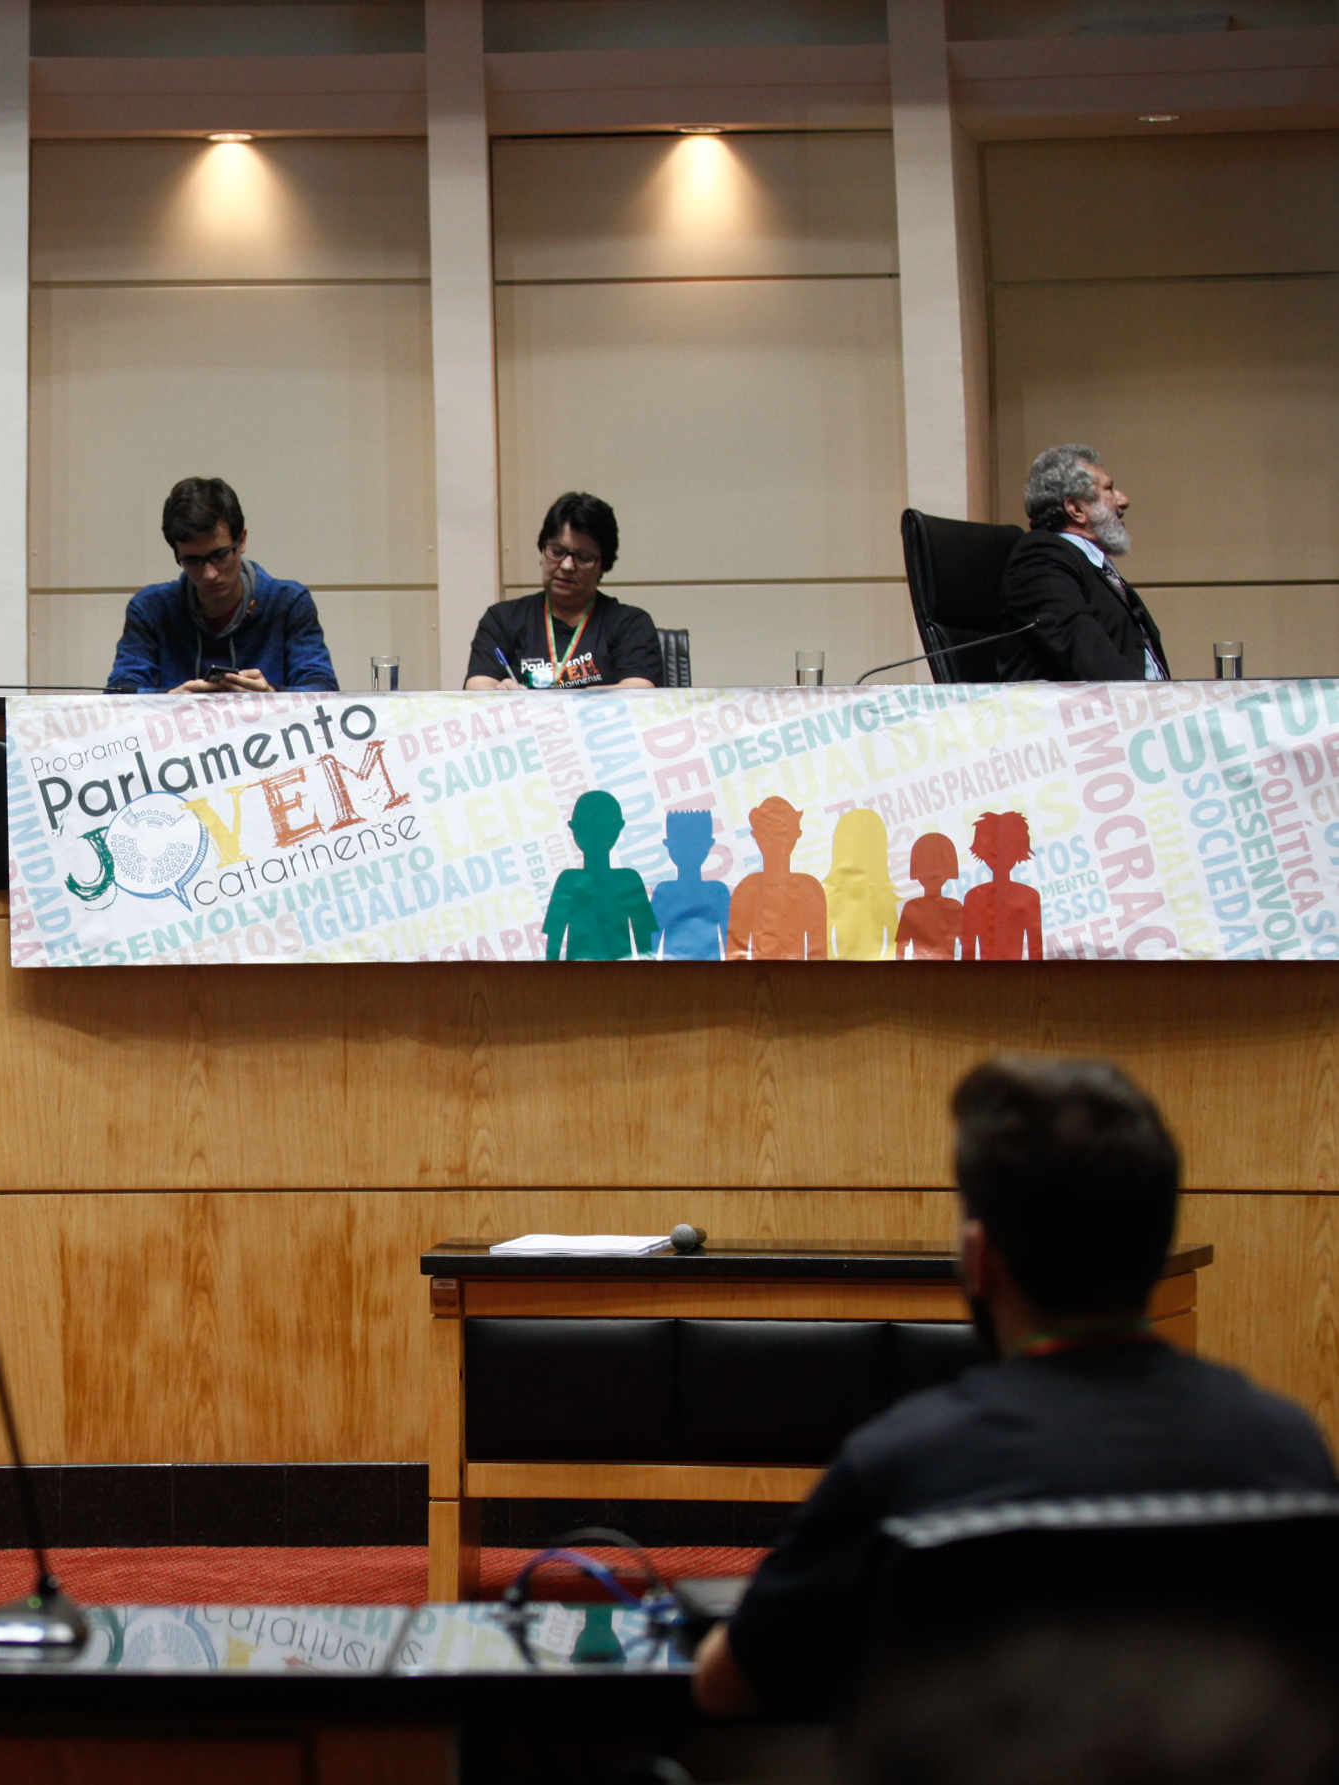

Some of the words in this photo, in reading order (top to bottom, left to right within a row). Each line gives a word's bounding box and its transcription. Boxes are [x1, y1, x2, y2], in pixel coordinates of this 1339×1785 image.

[30, 736, 140, 778] Programa
[37, 704, 377, 830] Parlamento
[398, 697, 533, 764] DEBATE
[418, 735, 544, 804] SAÚDE
[719, 685, 1048, 827] IGUALDADE
[64, 740, 412, 910] JOVEM
[194, 815, 421, 906] catarinense
[429, 778, 561, 863] LEIS
[1253, 752, 1325, 916] POLÍTICA
[294, 846, 521, 947] IGUALDADE
